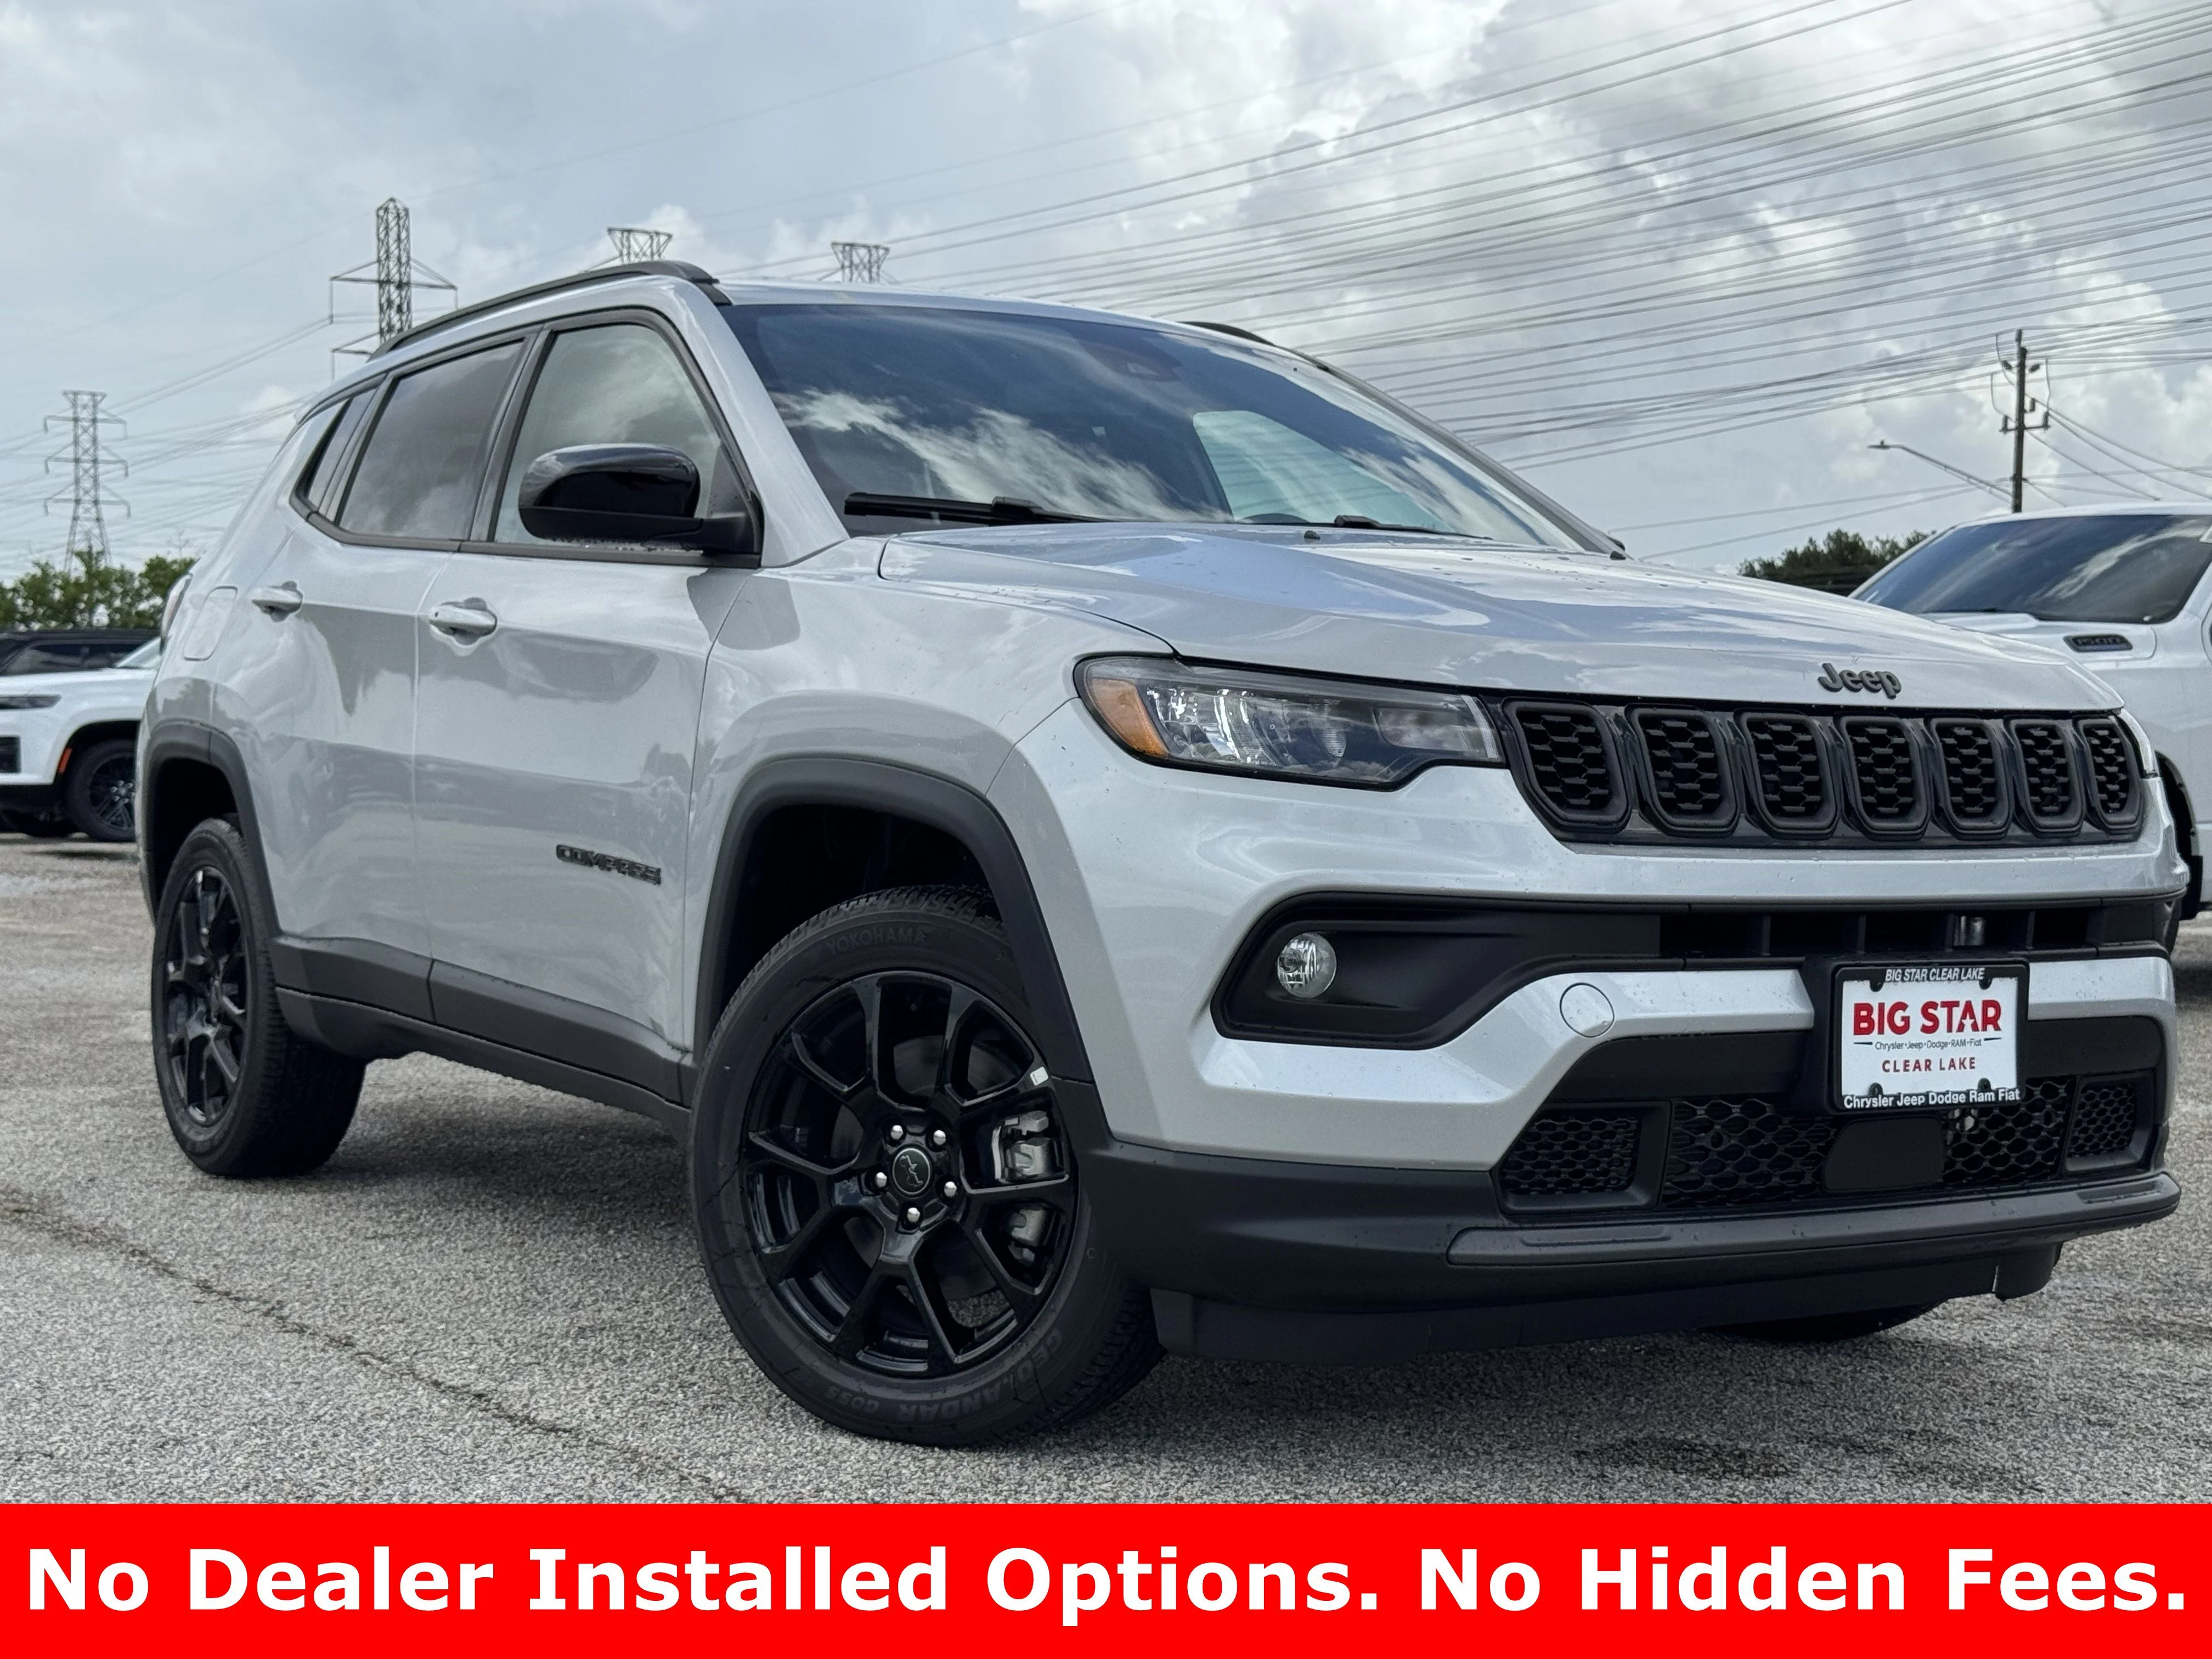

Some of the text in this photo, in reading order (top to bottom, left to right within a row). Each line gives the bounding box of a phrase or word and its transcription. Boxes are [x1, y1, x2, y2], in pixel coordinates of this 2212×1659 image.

[1818, 662, 1902, 699] Jeep
[556, 844, 662, 886] COMPASS
[826, 926, 927, 956] YOKOHAMA
[1885, 967, 1985, 981] BIG STAR CLEAR LAKE
[1853, 1000, 2002, 1036] BIG STAR
[1882, 1057, 1976, 1073] CLEAR LAKE
[1844, 1088, 2021, 1109] Chrysler Jeep Dodge Ram Fiat
[898, 1327, 1063, 1422] GEOLANDAR
